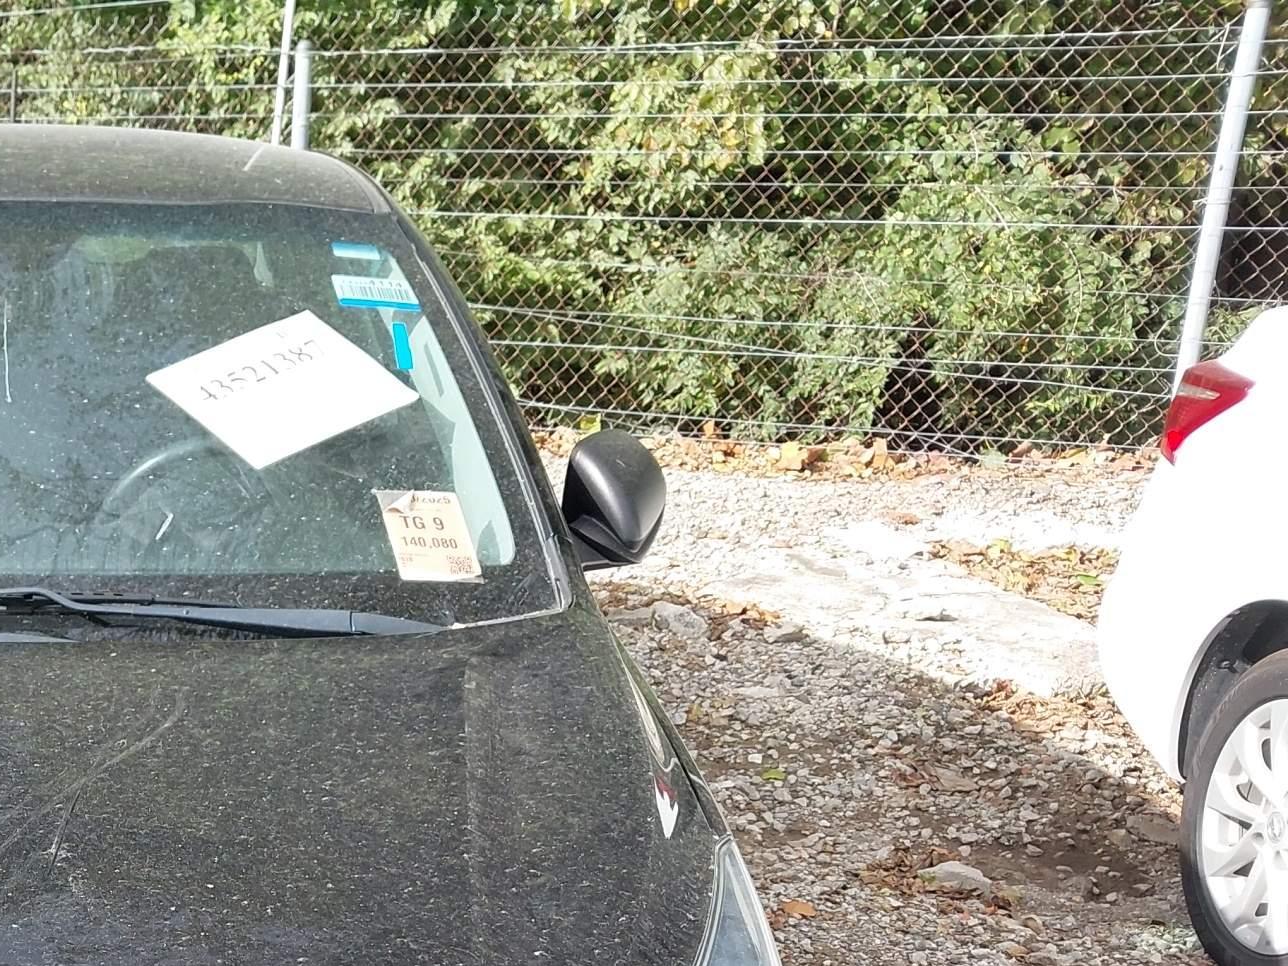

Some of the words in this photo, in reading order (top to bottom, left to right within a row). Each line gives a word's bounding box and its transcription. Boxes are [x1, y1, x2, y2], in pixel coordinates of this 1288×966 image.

[200, 339, 325, 400] 43521387
[399, 515, 426, 530] TG
[432, 516, 445, 531] 9
